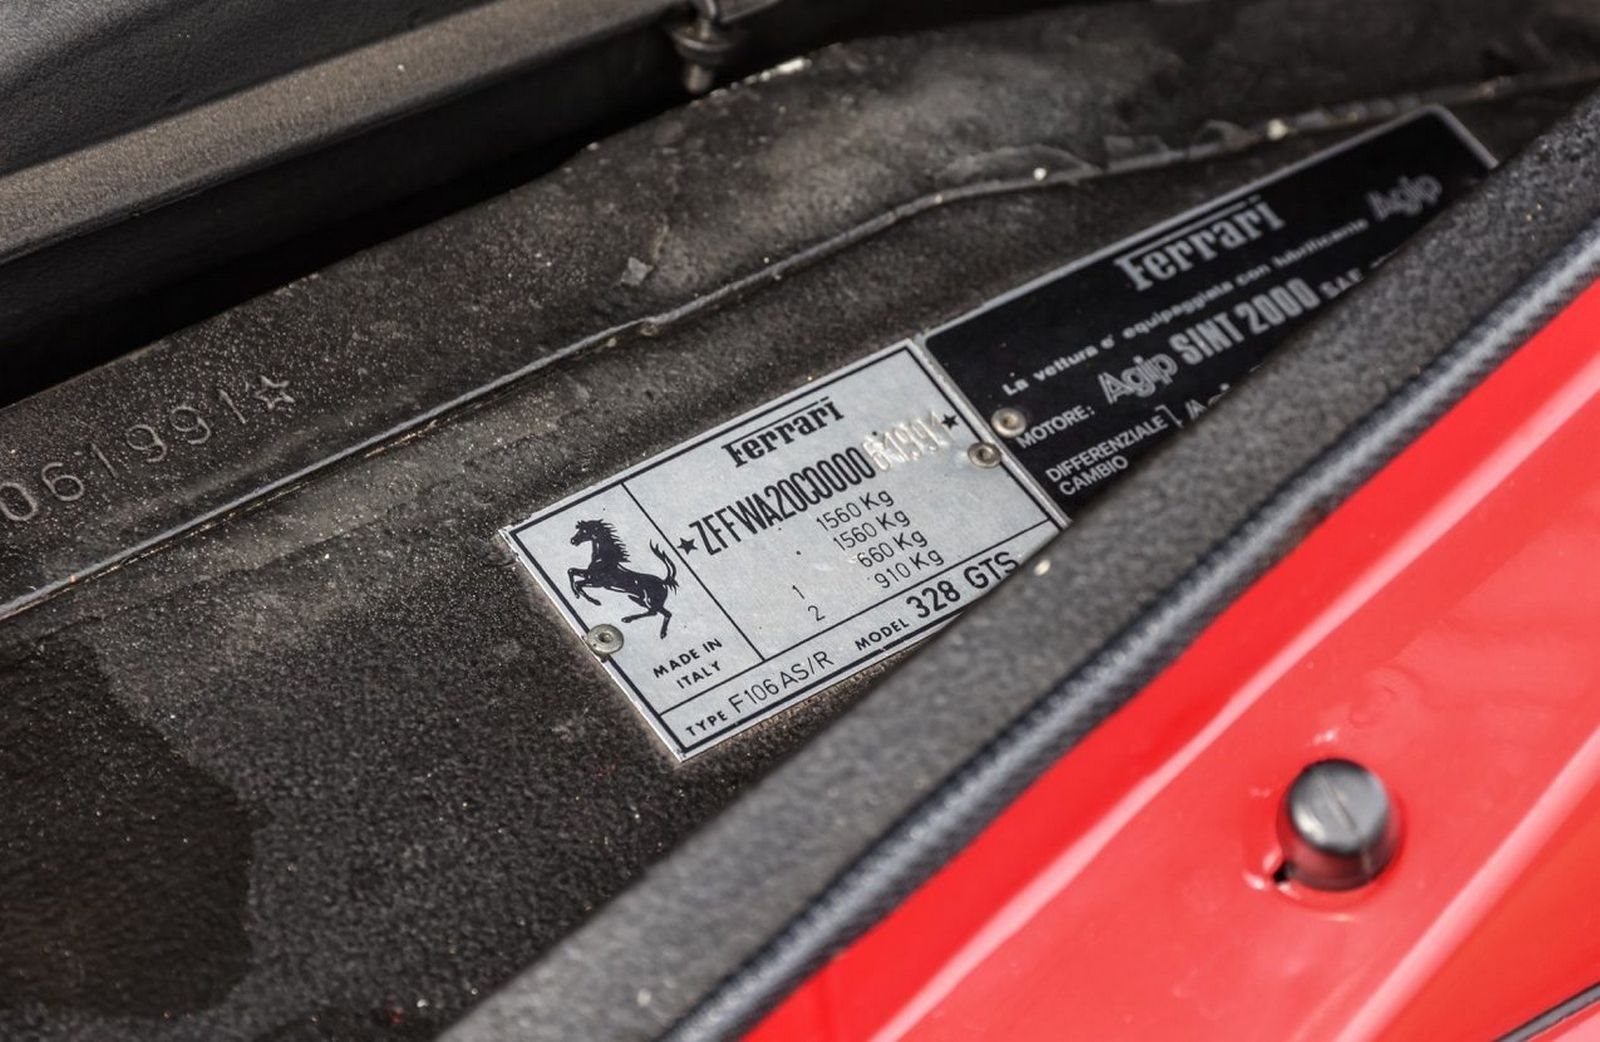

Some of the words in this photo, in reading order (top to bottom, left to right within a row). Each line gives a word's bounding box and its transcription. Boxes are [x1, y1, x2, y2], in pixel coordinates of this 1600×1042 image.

[1113, 195, 1285, 291] Ferrari
[1002, 378, 1029, 396] La
[1033, 345, 1099, 381] vettura
[1234, 264, 1271, 287] con
[1367, 174, 1443, 221] Agip
[1015, 405, 1095, 448] MOTORE:
[1098, 353, 1179, 405] Agip
[1168, 311, 1245, 365] SINT
[1233, 277, 1321, 334] 2000
[721, 396, 845, 468] Ferrari
[1045, 415, 1169, 483] DIFFERENZIALE
[1058, 454, 1129, 496] CAMBIO
[816, 502, 863, 532] 1560
[859, 490, 895, 510] Kg
[833, 522, 878, 551] 1560
[875, 510, 911, 530] Kg
[856, 542, 895, 568] 660
[892, 530, 928, 551] Kg
[792, 585, 805, 600] 1
[874, 562, 912, 589] 910
[909, 549, 945, 570] Kg
[807, 605, 826, 622] 2
[653, 649, 701, 678] MADE
[702, 638, 723, 654] IN
[685, 710, 727, 737] TYPE
[854, 618, 910, 652] MODEL
[906, 580, 961, 619] 328
[963, 551, 1020, 590] GTS
[676, 660, 721, 689] ITALY
